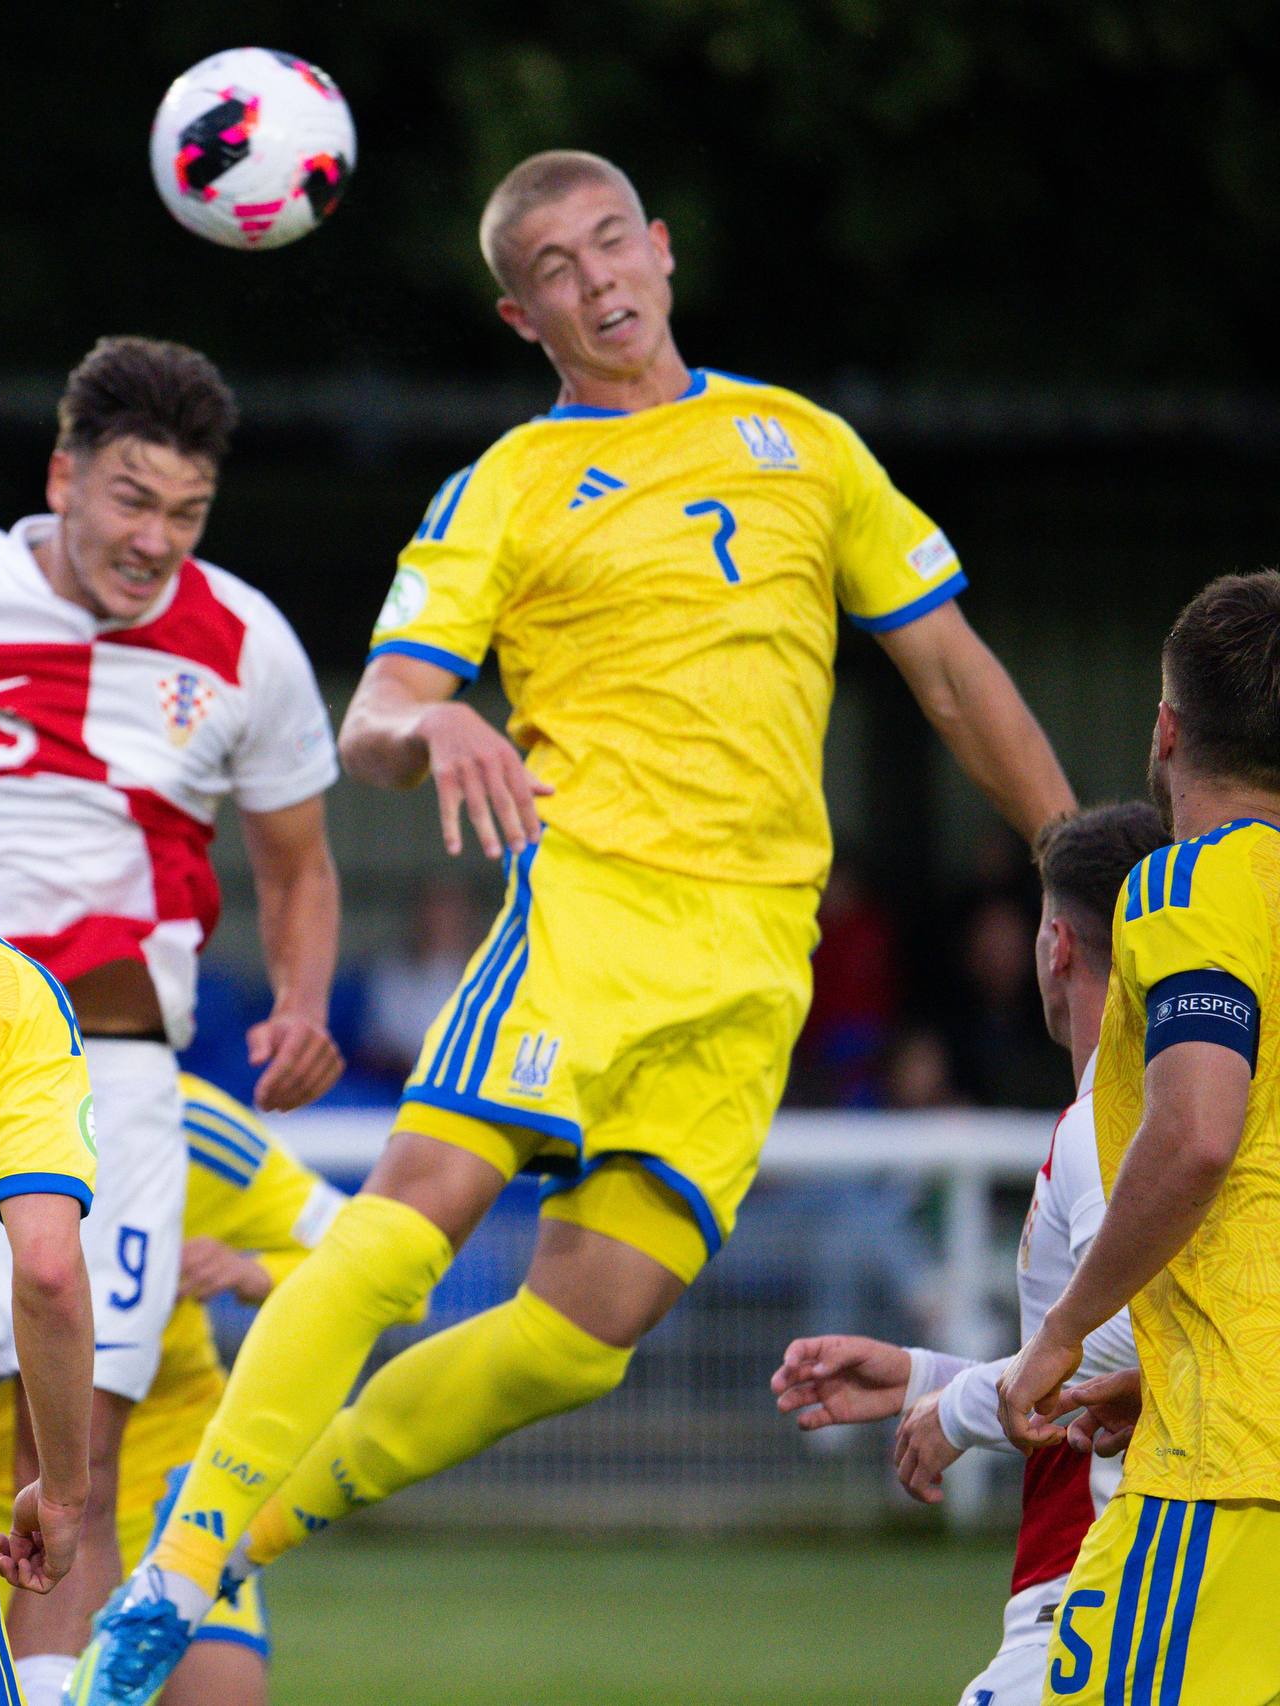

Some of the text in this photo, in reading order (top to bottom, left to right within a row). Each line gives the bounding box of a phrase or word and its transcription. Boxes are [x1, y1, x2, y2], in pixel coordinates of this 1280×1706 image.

[684, 498, 741, 583] 7
[1177, 997, 1251, 1024] RESPECT
[110, 1225, 148, 1310] 9
[1050, 1589, 1106, 1695] 5
